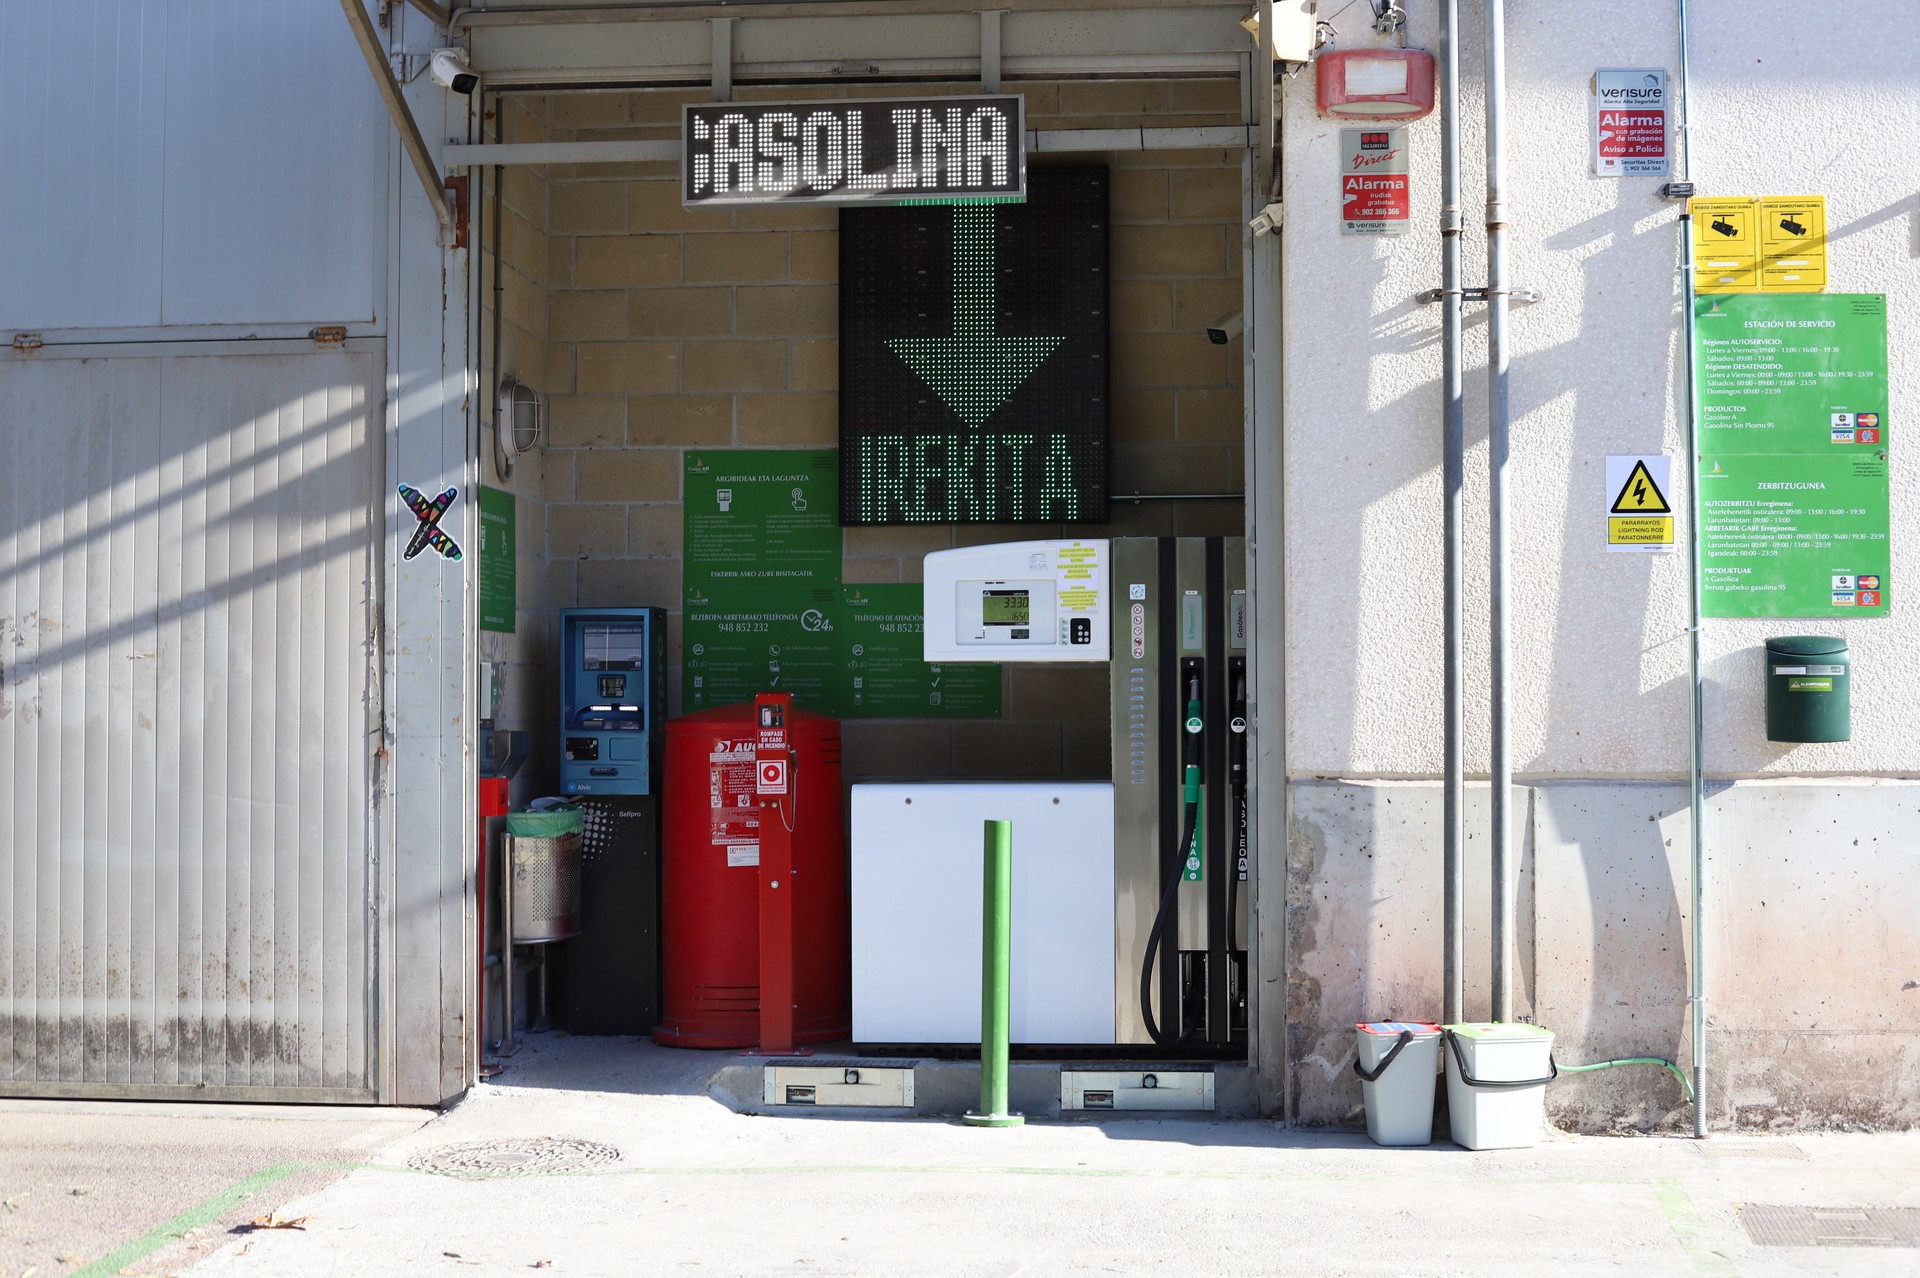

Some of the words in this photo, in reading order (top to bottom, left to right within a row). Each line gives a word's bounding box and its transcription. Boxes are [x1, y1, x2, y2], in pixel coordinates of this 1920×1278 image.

[1601, 88, 1662, 97] verisure
[1601, 113, 1663, 126] Alarma
[1628, 135, 1662, 143] imágenes
[1352, 149, 1401, 170] Direct
[1346, 178, 1404, 189] Alarma
[1744, 320, 1783, 328] ESTACIÓN
[1786, 320, 1797, 328] DE
[1798, 320, 1836, 328] SERVICIO
[1705, 363, 1731, 371] Régimen
[1707, 388, 1742, 396] Domingos:
[861, 434, 1078, 522] IREKITA
[1758, 482, 1826, 490] ZERBITZUGUNEA
[1757, 500, 1793, 508] Erregimena:
[1761, 525, 1797, 533] Erregimena:
[1708, 550, 1739, 558] Igandeak:
[1725, 584, 1749, 592] gabeko
[1751, 584, 1778, 592] gasolina
[719, 623, 734, 632] 948
[736, 623, 751, 632] 852
[754, 623, 768, 632] 232
[813, 619, 833, 632] 24h
[880, 624, 895, 632] 948
[897, 624, 912, 632] 852
